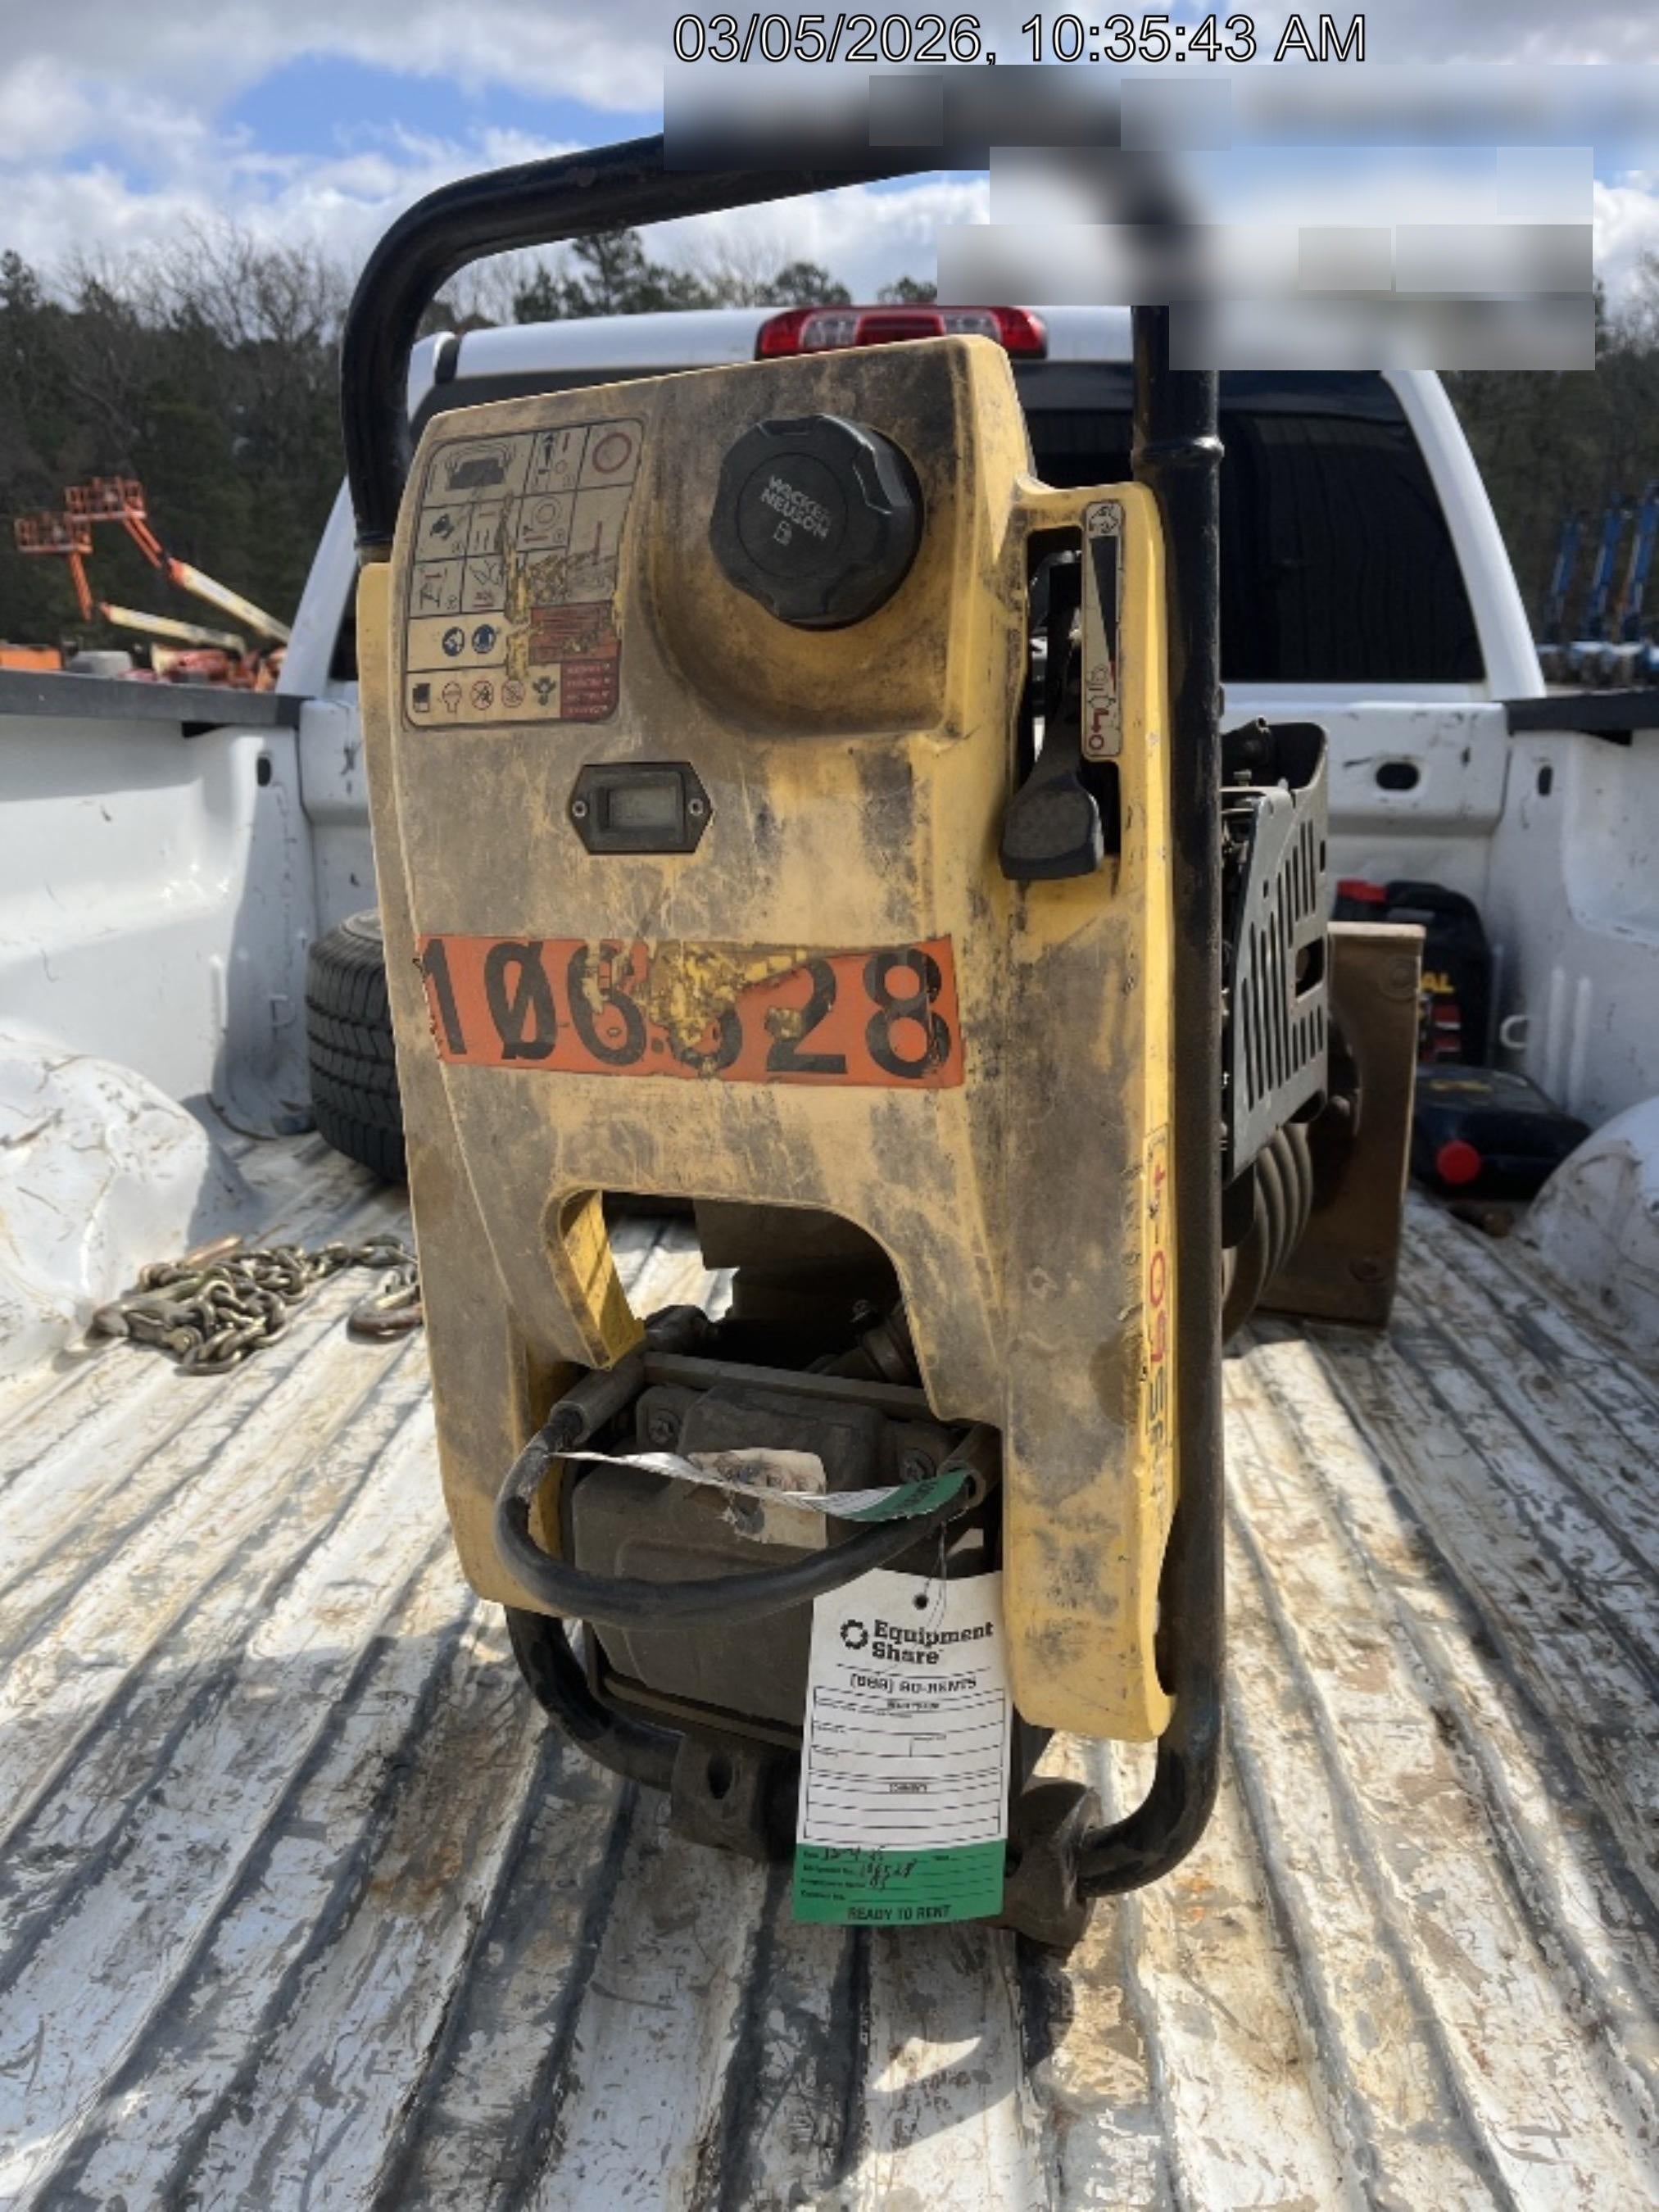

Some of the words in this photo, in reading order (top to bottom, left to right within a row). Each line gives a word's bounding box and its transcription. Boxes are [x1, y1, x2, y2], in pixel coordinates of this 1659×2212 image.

[761, 488, 830, 542] NEUSON
[874, 1619, 994, 1647] Equipment
[872, 1642, 940, 1665] Share
[847, 1906, 893, 1921] READY
[897, 1907, 913, 1920] TO
[917, 1904, 952, 1920] RENT
